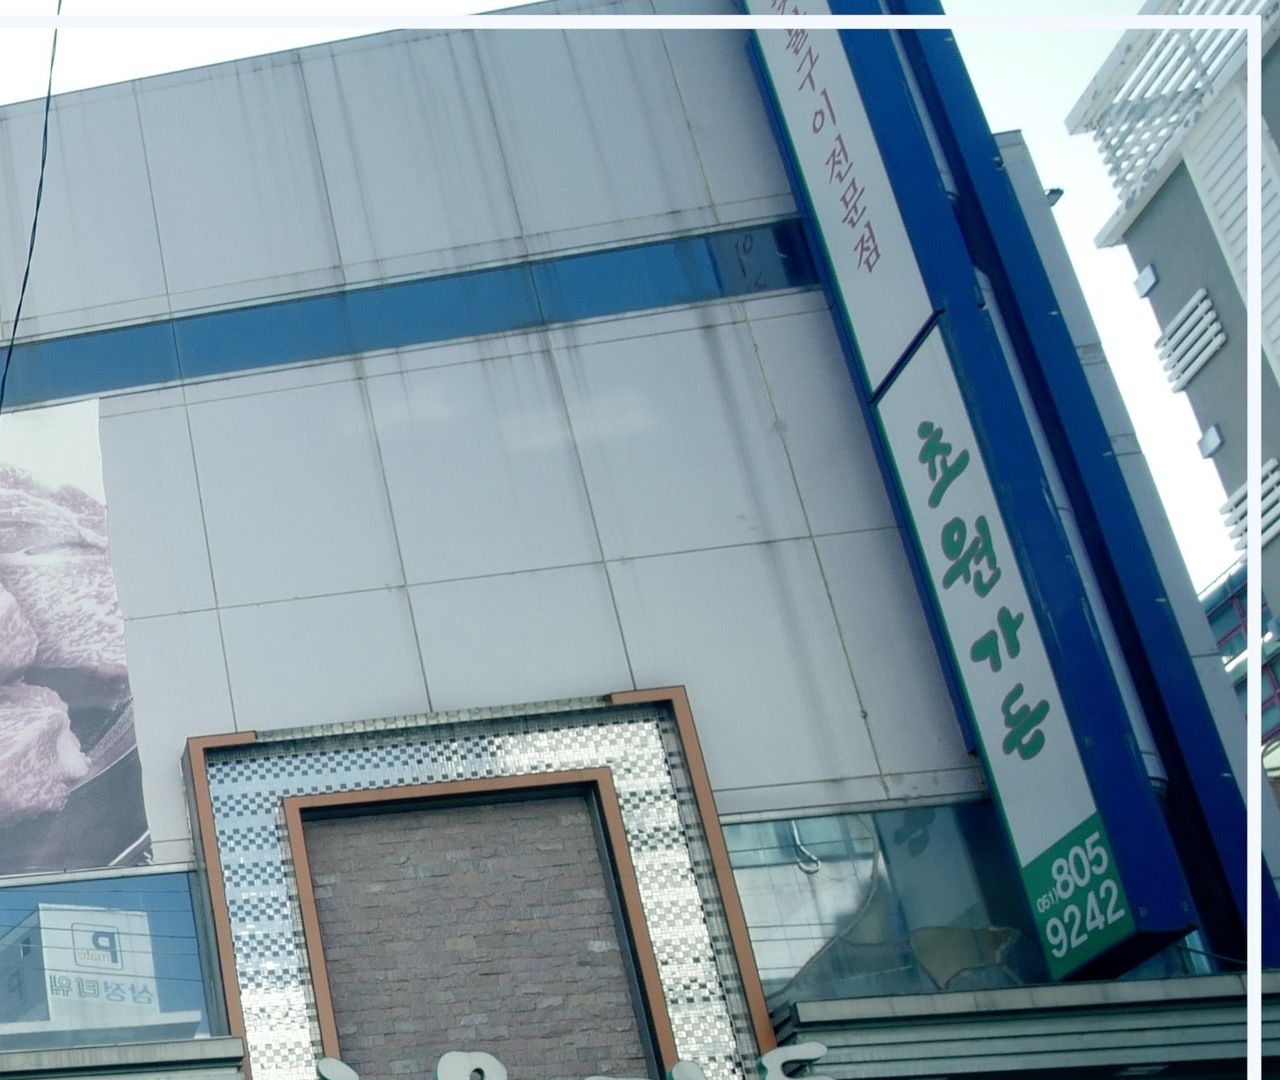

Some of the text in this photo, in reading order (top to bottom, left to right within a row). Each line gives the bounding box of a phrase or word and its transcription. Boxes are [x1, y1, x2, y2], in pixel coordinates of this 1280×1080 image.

[916, 420, 1050, 761] 초원가든
[1052, 831, 1109, 899] 805
[1045, 879, 1126, 958] 9242
